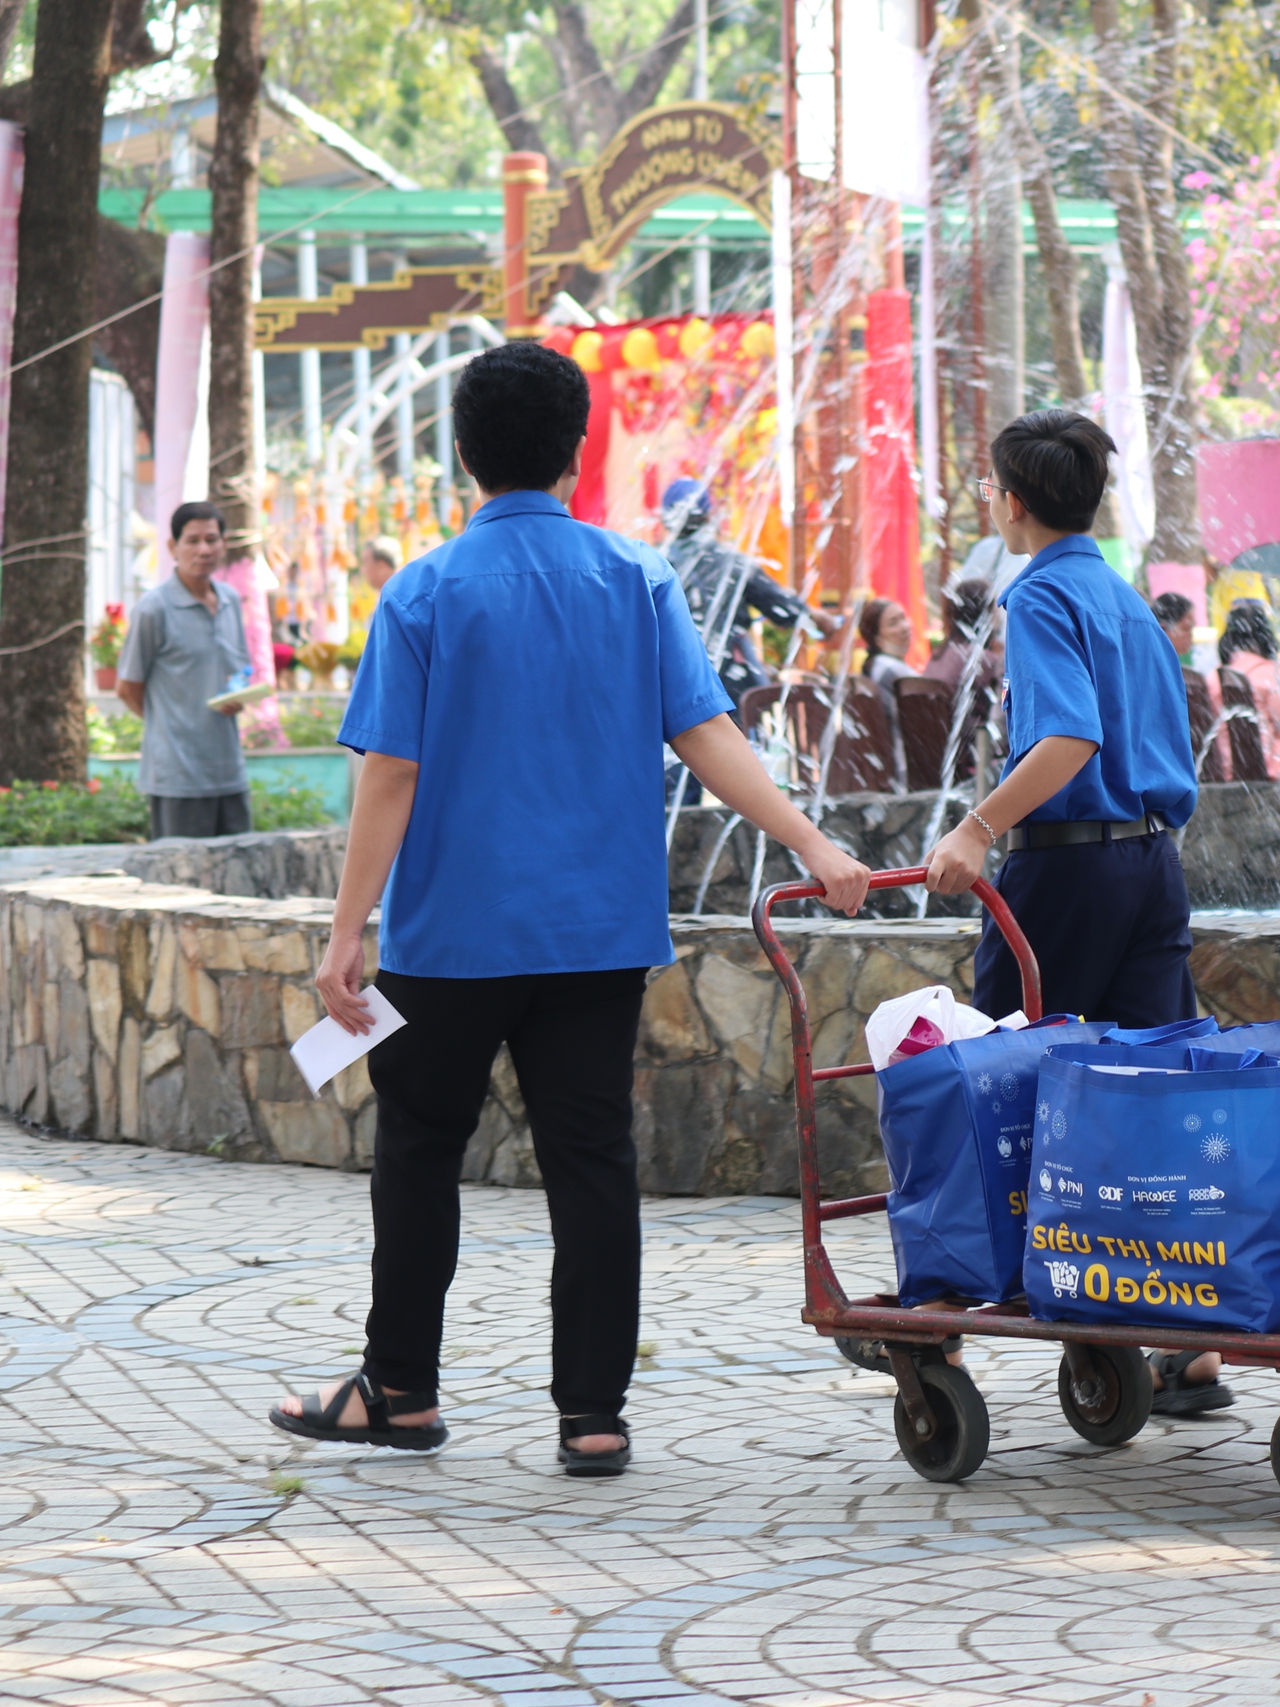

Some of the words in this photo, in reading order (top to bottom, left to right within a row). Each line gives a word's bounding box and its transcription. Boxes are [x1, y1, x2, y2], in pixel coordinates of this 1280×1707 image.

[1067, 1180, 1083, 1197] PNJ
[1032, 1222, 1092, 1254] SIÊU
[1097, 1236, 1152, 1267] THỊ
[1156, 1240, 1226, 1267] MINI
[1084, 1263, 1110, 1302] 0
[1114, 1268, 1219, 1307] ĐỒNG
